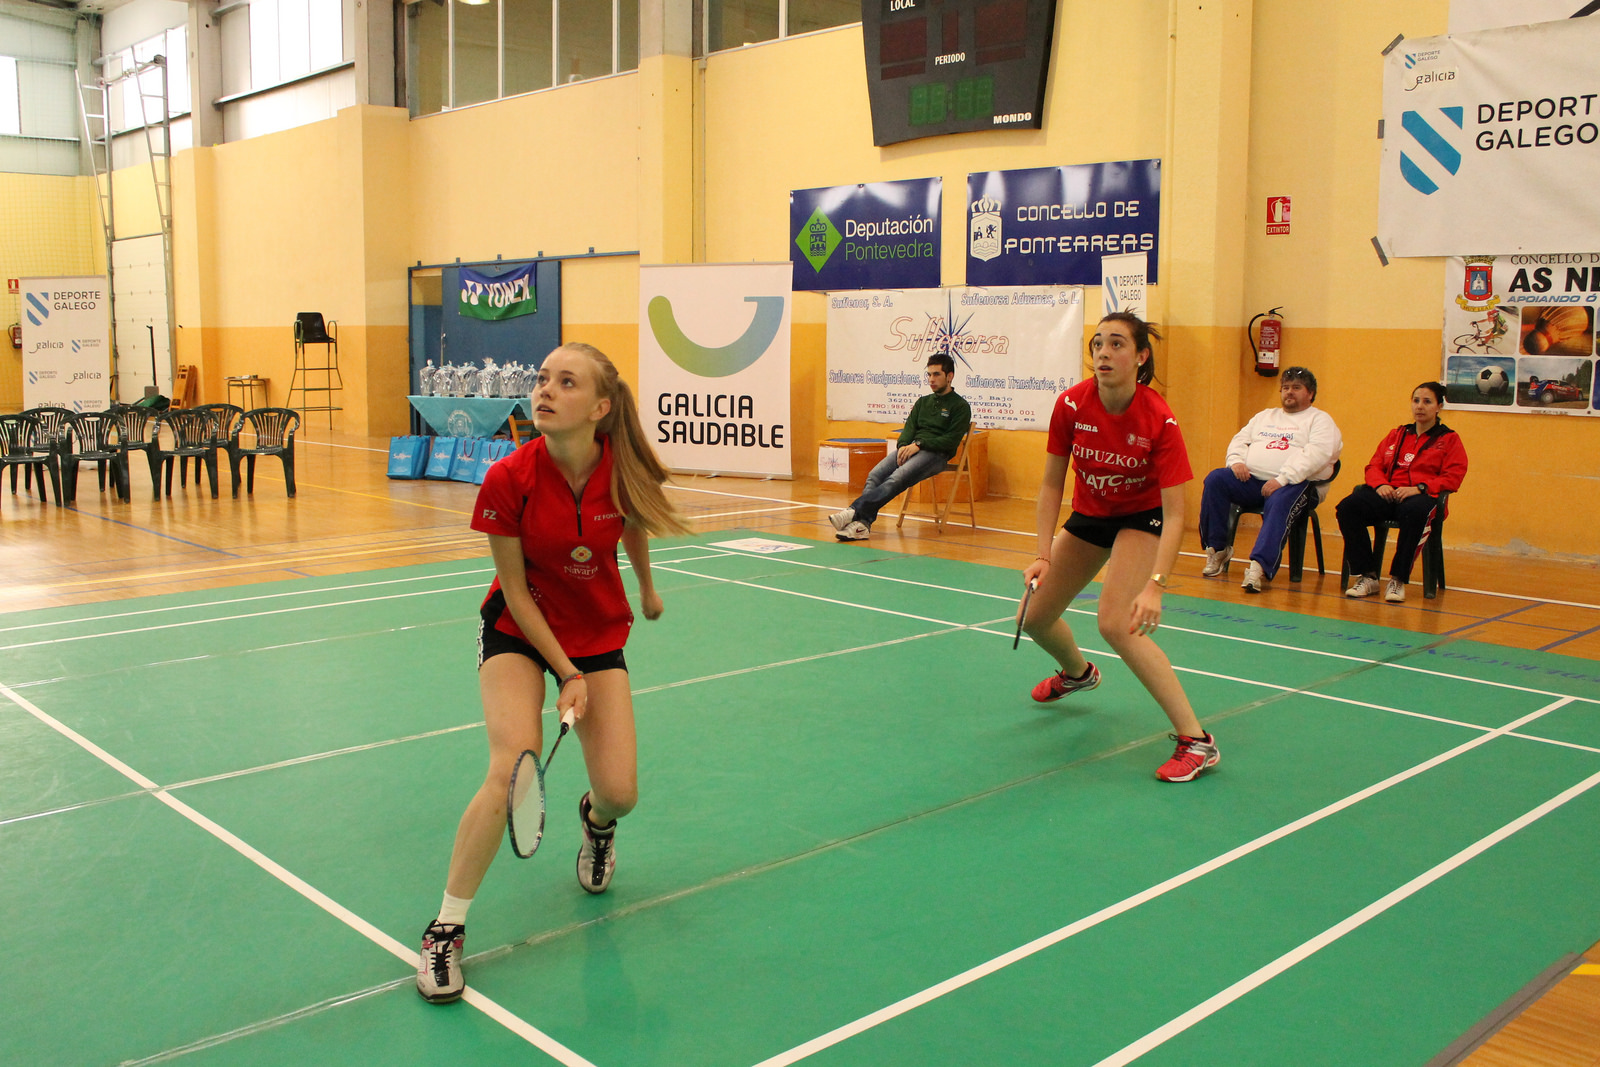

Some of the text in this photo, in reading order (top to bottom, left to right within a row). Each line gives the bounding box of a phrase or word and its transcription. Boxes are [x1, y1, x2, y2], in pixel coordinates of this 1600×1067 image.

[890, 0, 916, 12] LOCAL
[934, 52, 966, 66] PERIODO
[1478, 94, 1600, 124] DEPORT
[993, 112, 1032, 125] MONDO
[1475, 122, 1599, 151] GALEGO
[1016, 200, 1140, 223] CONCELLO DE
[845, 214, 934, 238] Deputación
[1266, 225, 1290, 234] EXTINTOR
[845, 239, 934, 261] Pontevedra
[1004, 232, 1154, 255] PONTEAREAS
[1510, 253, 1583, 265] CONCELLO
[1119, 274, 1144, 287] DEPORTE
[1508, 267, 1553, 293] AS
[53, 290, 101, 301] DEPORTE
[484, 274, 532, 308] YONEX
[1119, 289, 1142, 301] GALEGO
[53, 301, 97, 311] GALEGO
[831, 297, 869, 310] Suflenor,
[960, 292, 1010, 306] Suflenorsa
[1011, 292, 1055, 307] Aduanas,
[1506, 295, 1581, 303] APOIANDO
[884, 316, 1011, 362] Suflenorsa
[829, 370, 865, 384] Suflenorsa
[965, 374, 1006, 389] Suflenorsa
[1007, 376, 1057, 394] Transitarios,
[657, 393, 754, 419] GALICIA
[657, 420, 784, 449] SAUDABLE
[1072, 443, 1148, 468] GIPUZKOA
[482, 509, 497, 520] FZ
